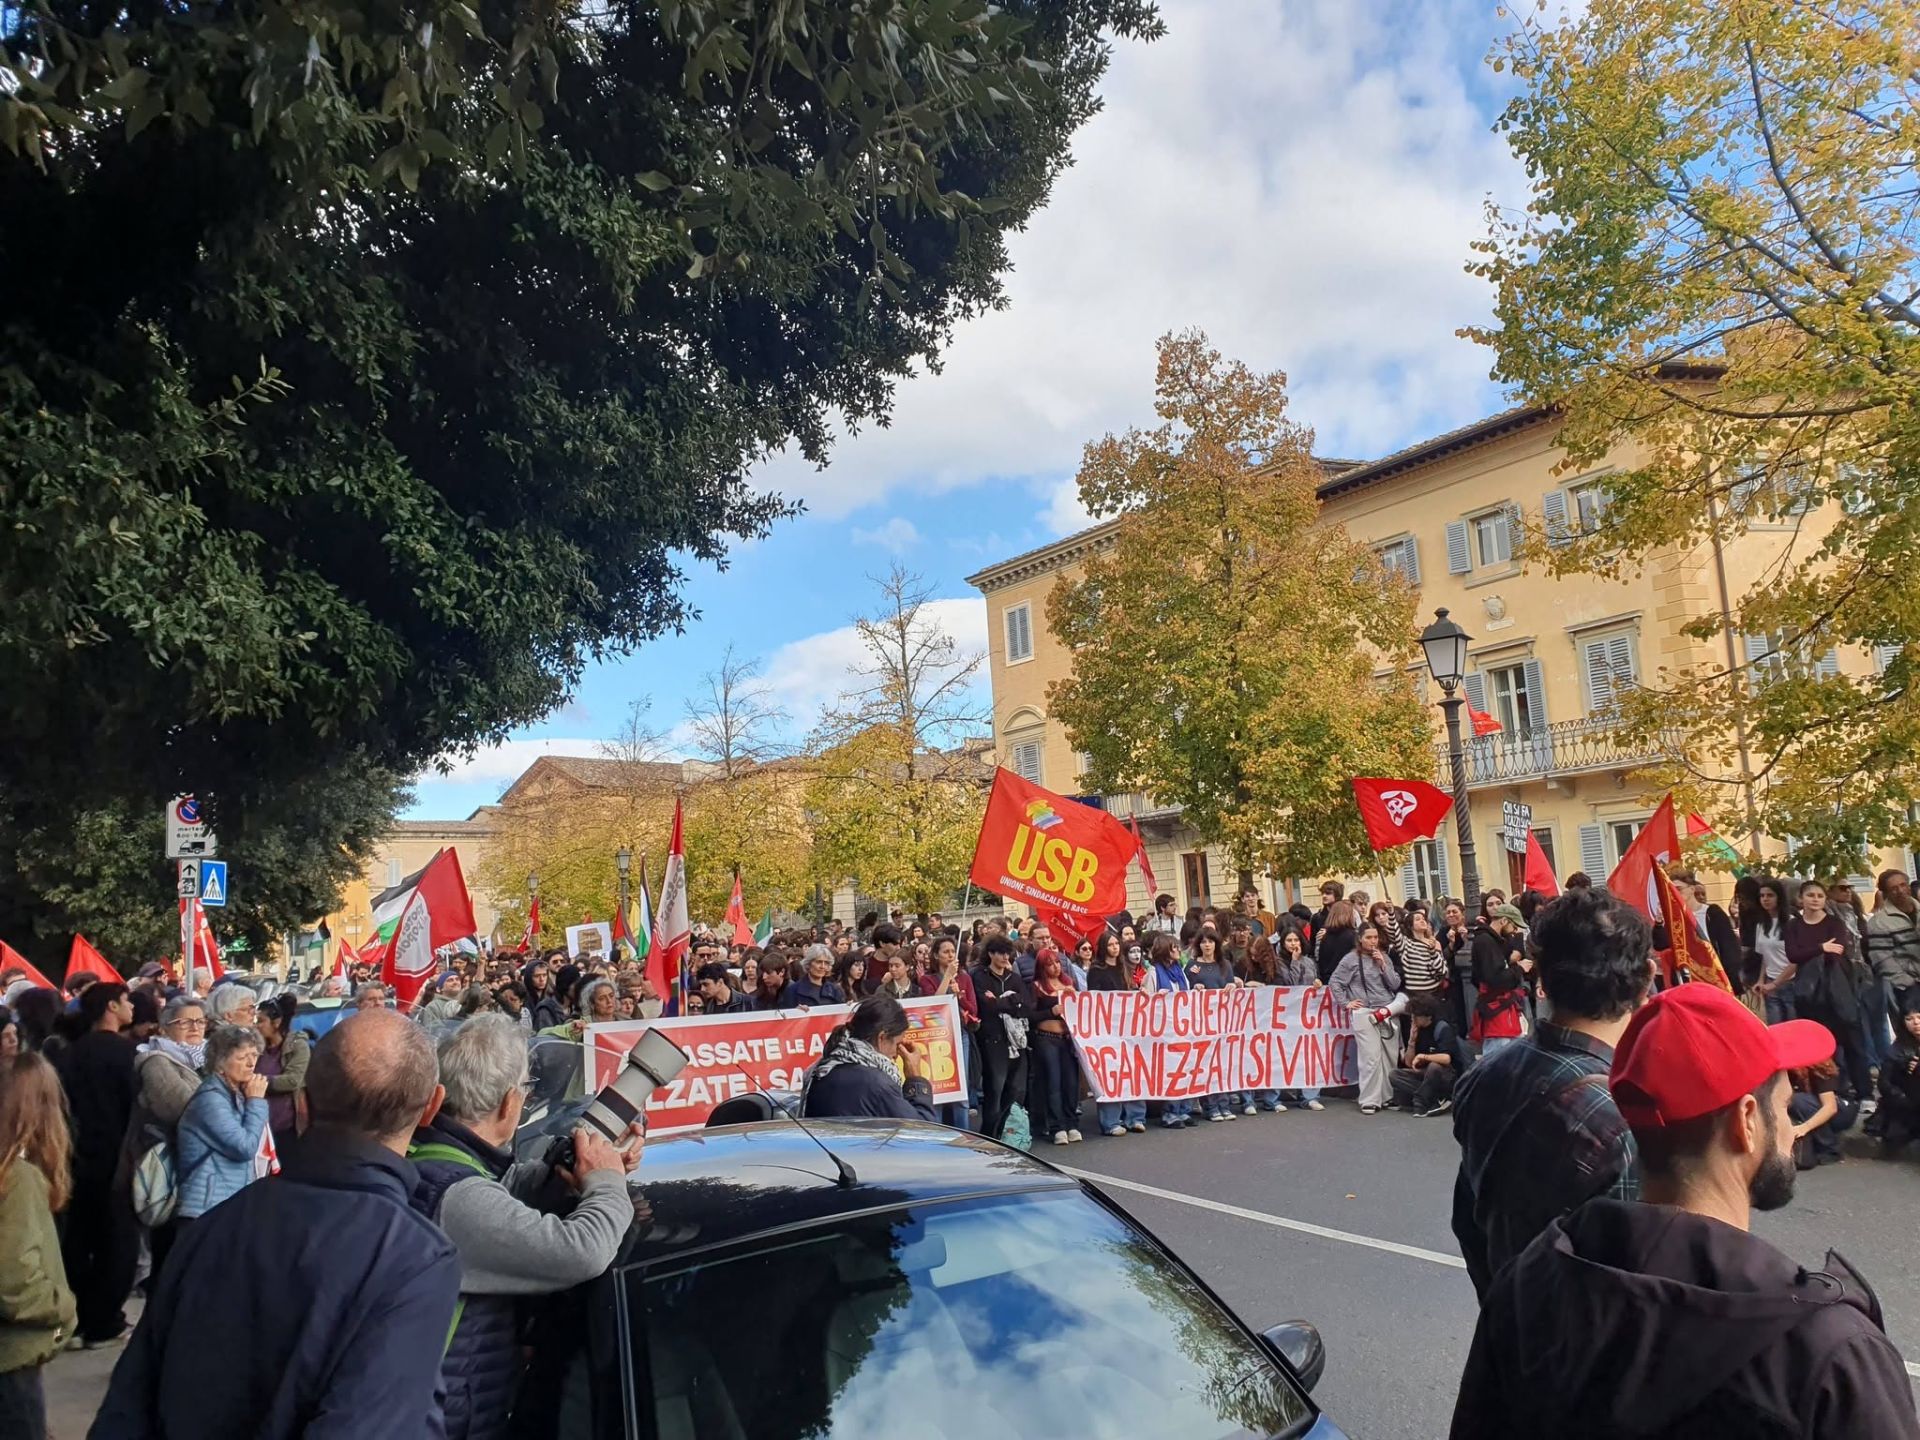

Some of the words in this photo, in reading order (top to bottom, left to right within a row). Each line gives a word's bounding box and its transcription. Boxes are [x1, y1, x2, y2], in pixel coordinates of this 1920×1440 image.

[1007, 823, 1098, 902] USB
[1000, 875, 1025, 892] UNIONE
[1025, 886, 1061, 906] SINDACALE
[1062, 900, 1070, 911] DI
[1061, 989, 1168, 1039] CONTRO
[1172, 987, 1257, 1036] GUERRA
[1271, 987, 1290, 1030] E
[785, 1038, 806, 1054] LE
[917, 1030, 946, 1038] IMPIEGO
[1088, 1033, 1246, 1098] RGANIZZATI
[646, 1072, 748, 1110] LZATE
